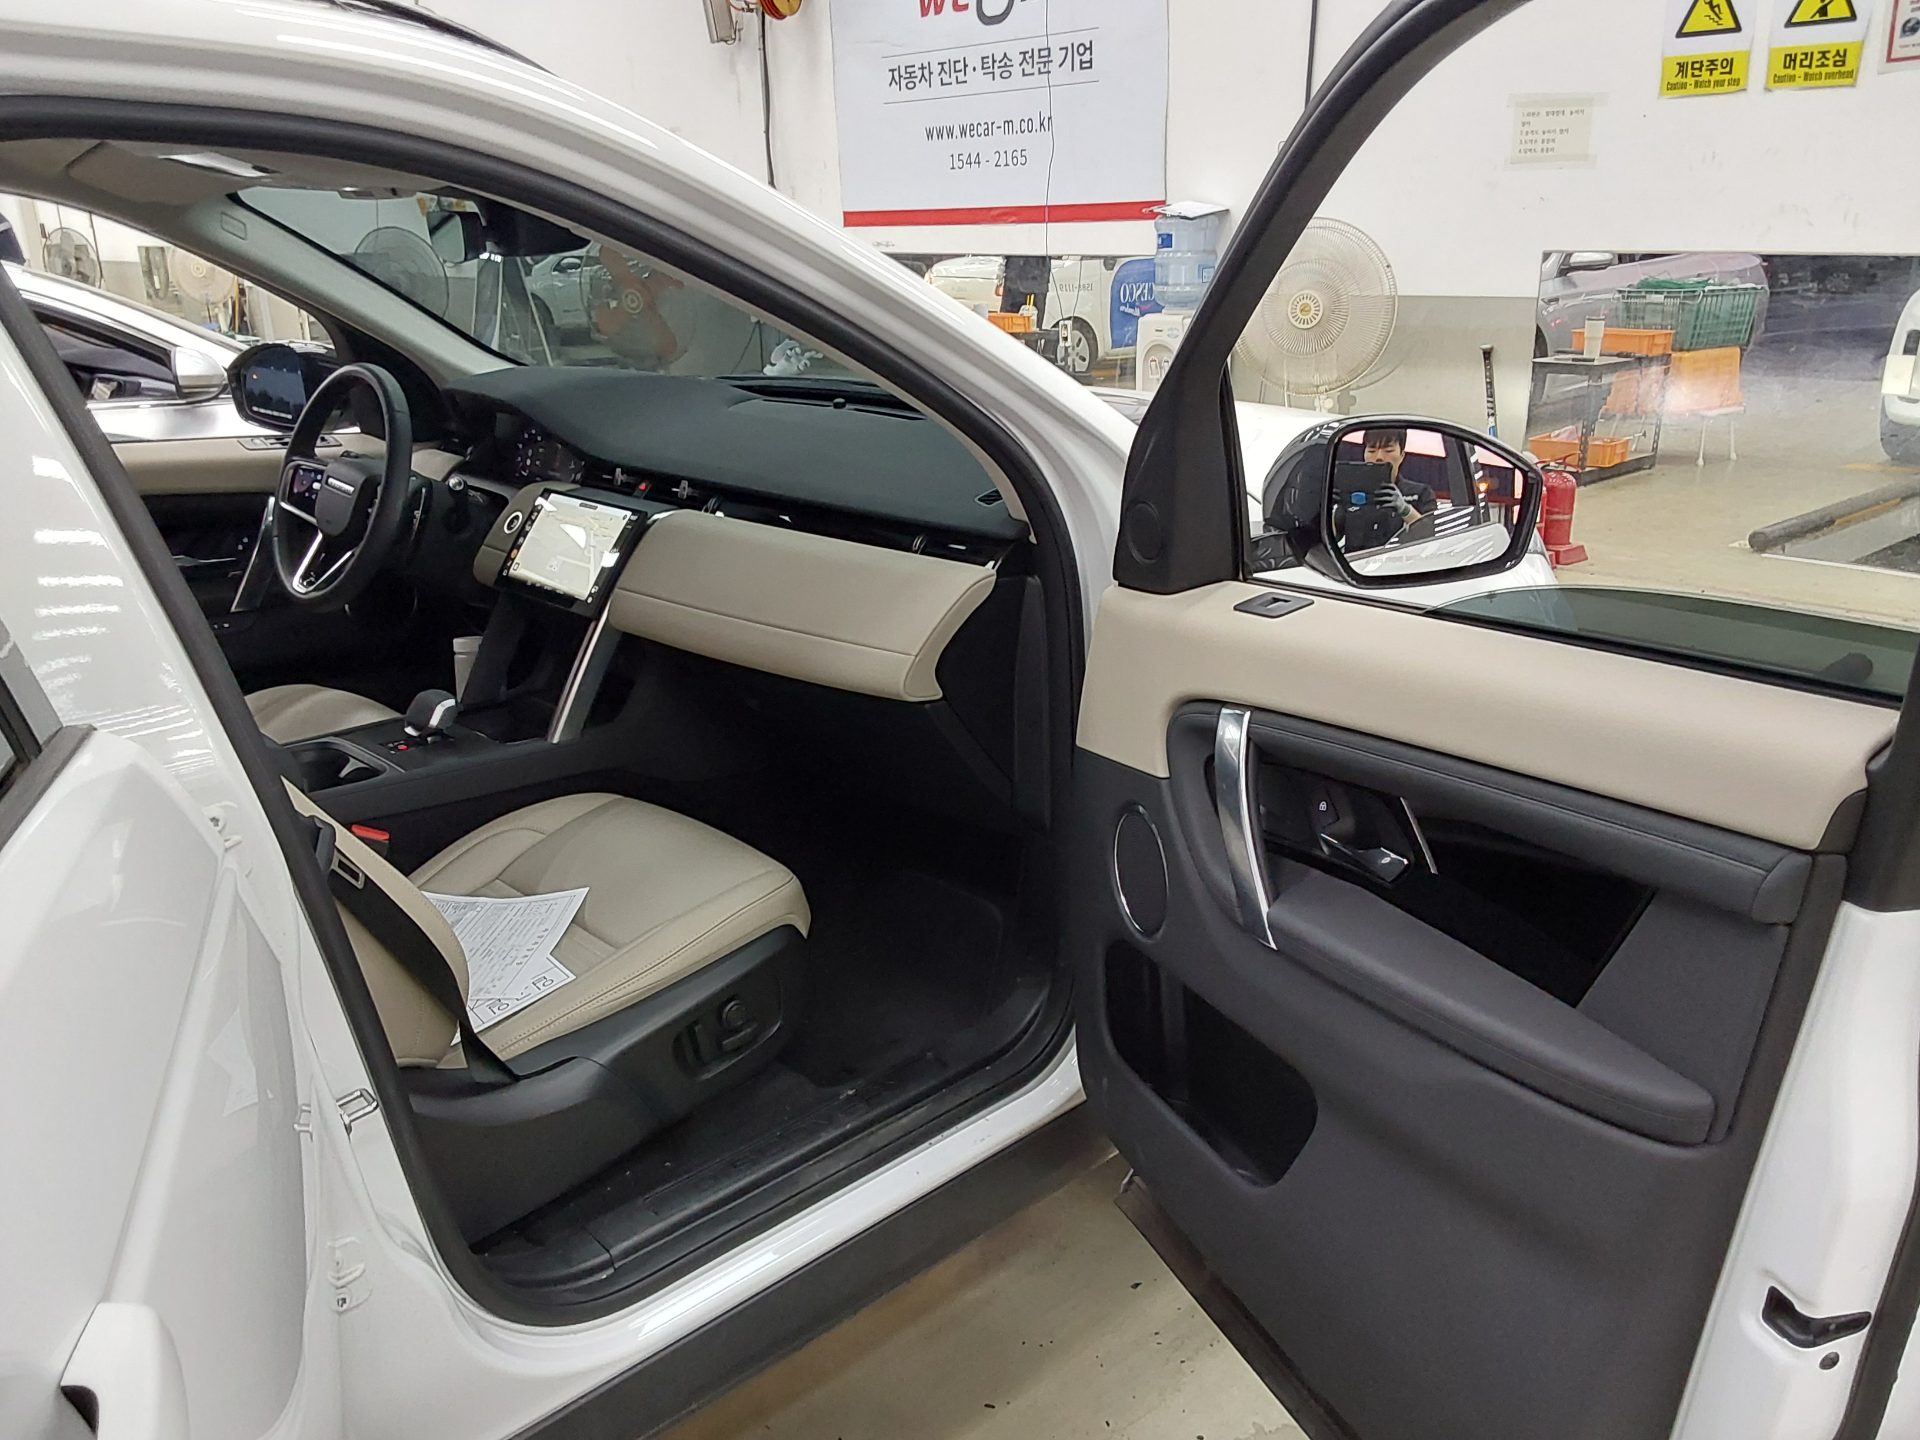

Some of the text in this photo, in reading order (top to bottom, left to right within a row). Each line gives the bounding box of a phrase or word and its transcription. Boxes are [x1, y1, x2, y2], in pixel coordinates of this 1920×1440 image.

[888, 60, 934, 92] 자동차
[1018, 47, 1053, 78] 전문
[1058, 39, 1094, 73] 기업
[1674, 57, 1734, 79] 계단주의
[1782, 48, 1848, 71] 머리조심
[1666, 81, 1688, 91] Caution
[1693, 79, 1712, 89] Watch
[1712, 79, 1727, 89] your
[1726, 77, 1741, 88] step
[1772, 72, 1797, 84] Caution
[1803, 70, 1823, 82] Watch
[1825, 69, 1854, 80] overhead
[925, 111, 1053, 141] www.wecar-m.co.kr
[949, 151, 982, 170] 1544
[993, 148, 1028, 168] 2165
